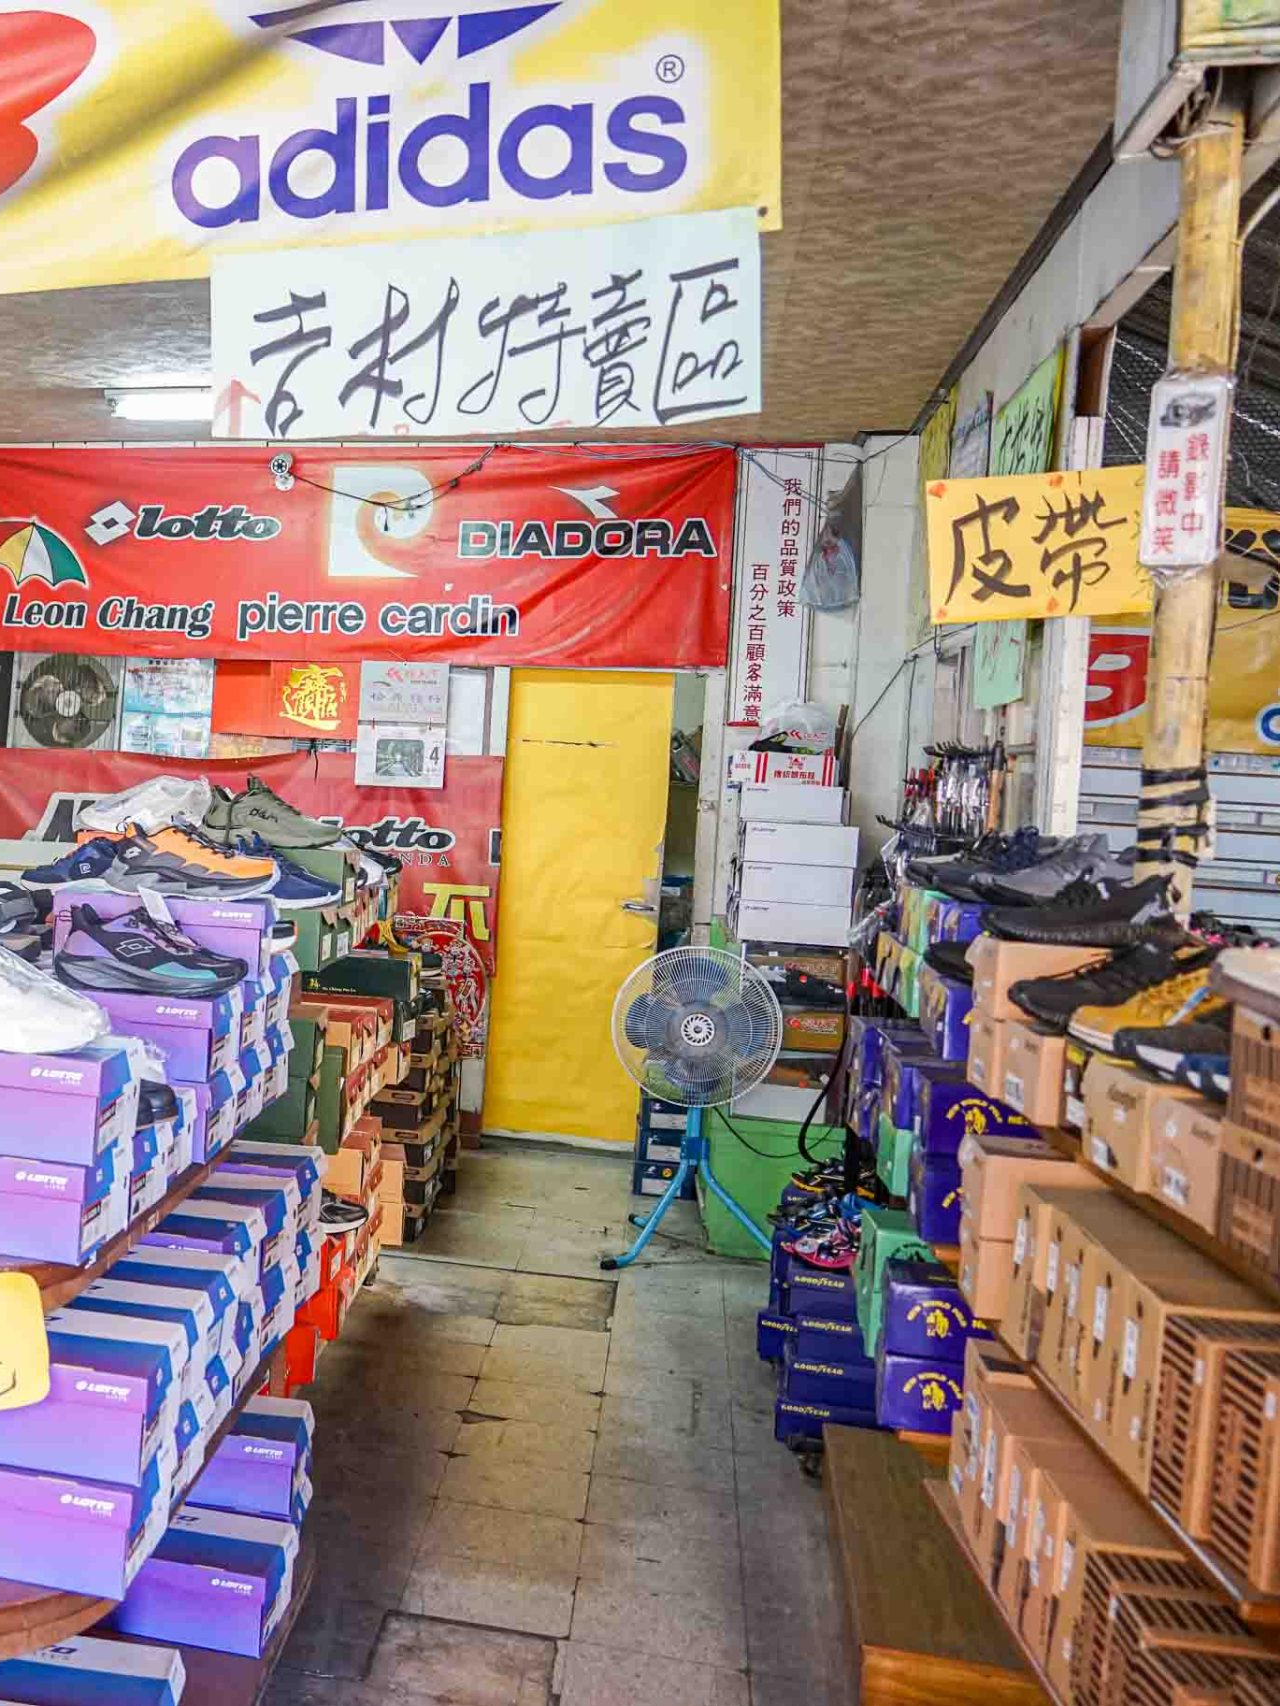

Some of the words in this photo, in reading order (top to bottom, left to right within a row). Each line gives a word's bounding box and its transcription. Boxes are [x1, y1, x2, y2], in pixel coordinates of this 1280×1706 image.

[171, 82, 688, 229] adidas
[135, 504, 282, 541] lotto
[457, 518, 717, 559] DIADORA
[777, 478, 803, 618] 我們的品質政策
[3, 594, 87, 629] Leon
[97, 597, 215, 638] Chang
[237, 593, 366, 641] pierre
[379, 594, 519, 637] cardin
[743, 564, 770, 722] 百分之百顧客滿意
[794, 1275, 846, 1288] GOODYEAR
[801, 1319, 853, 1333] GOODYEAR
[793, 1361, 845, 1375] GOODYEAR
[781, 1403, 830, 1417] GOODYEAR
